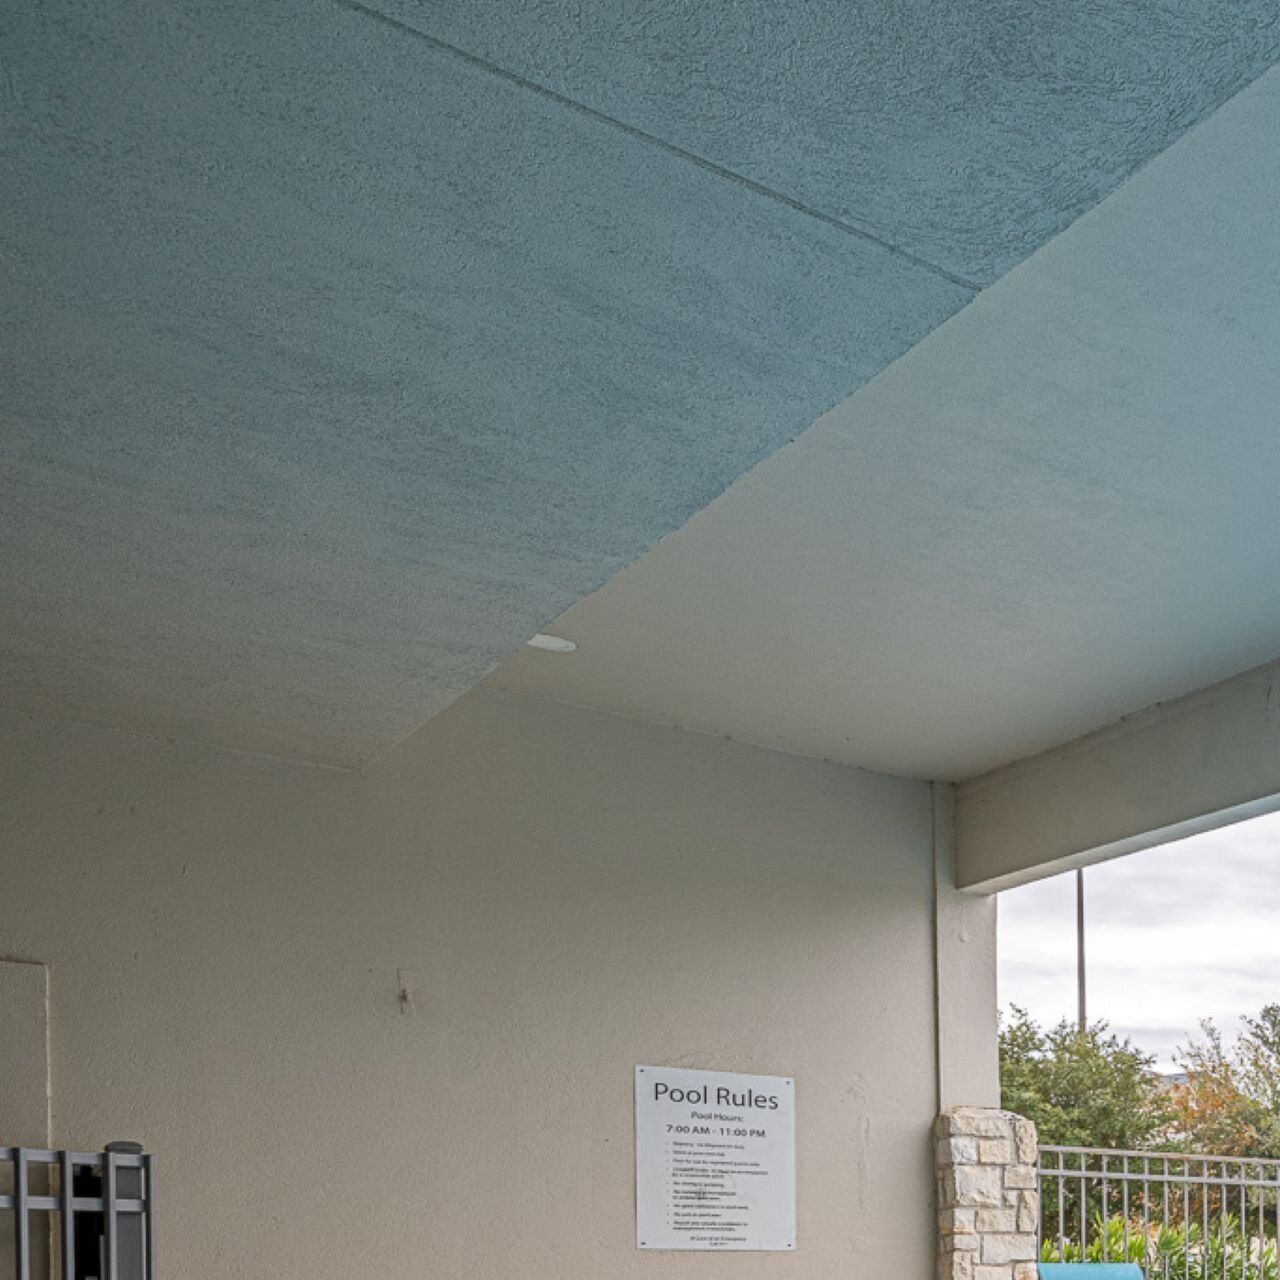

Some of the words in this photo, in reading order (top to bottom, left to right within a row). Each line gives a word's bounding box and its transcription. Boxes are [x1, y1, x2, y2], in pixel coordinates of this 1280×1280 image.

[654, 1082, 707, 1105] Pool
[717, 1087, 779, 1110] Rules
[691, 1111, 713, 1121] Pool
[666, 1124, 690, 1134] 7:00
[693, 1126, 711, 1135] AM
[719, 1127, 748, 1138] 11:00
[749, 1129, 766, 1138] PM
